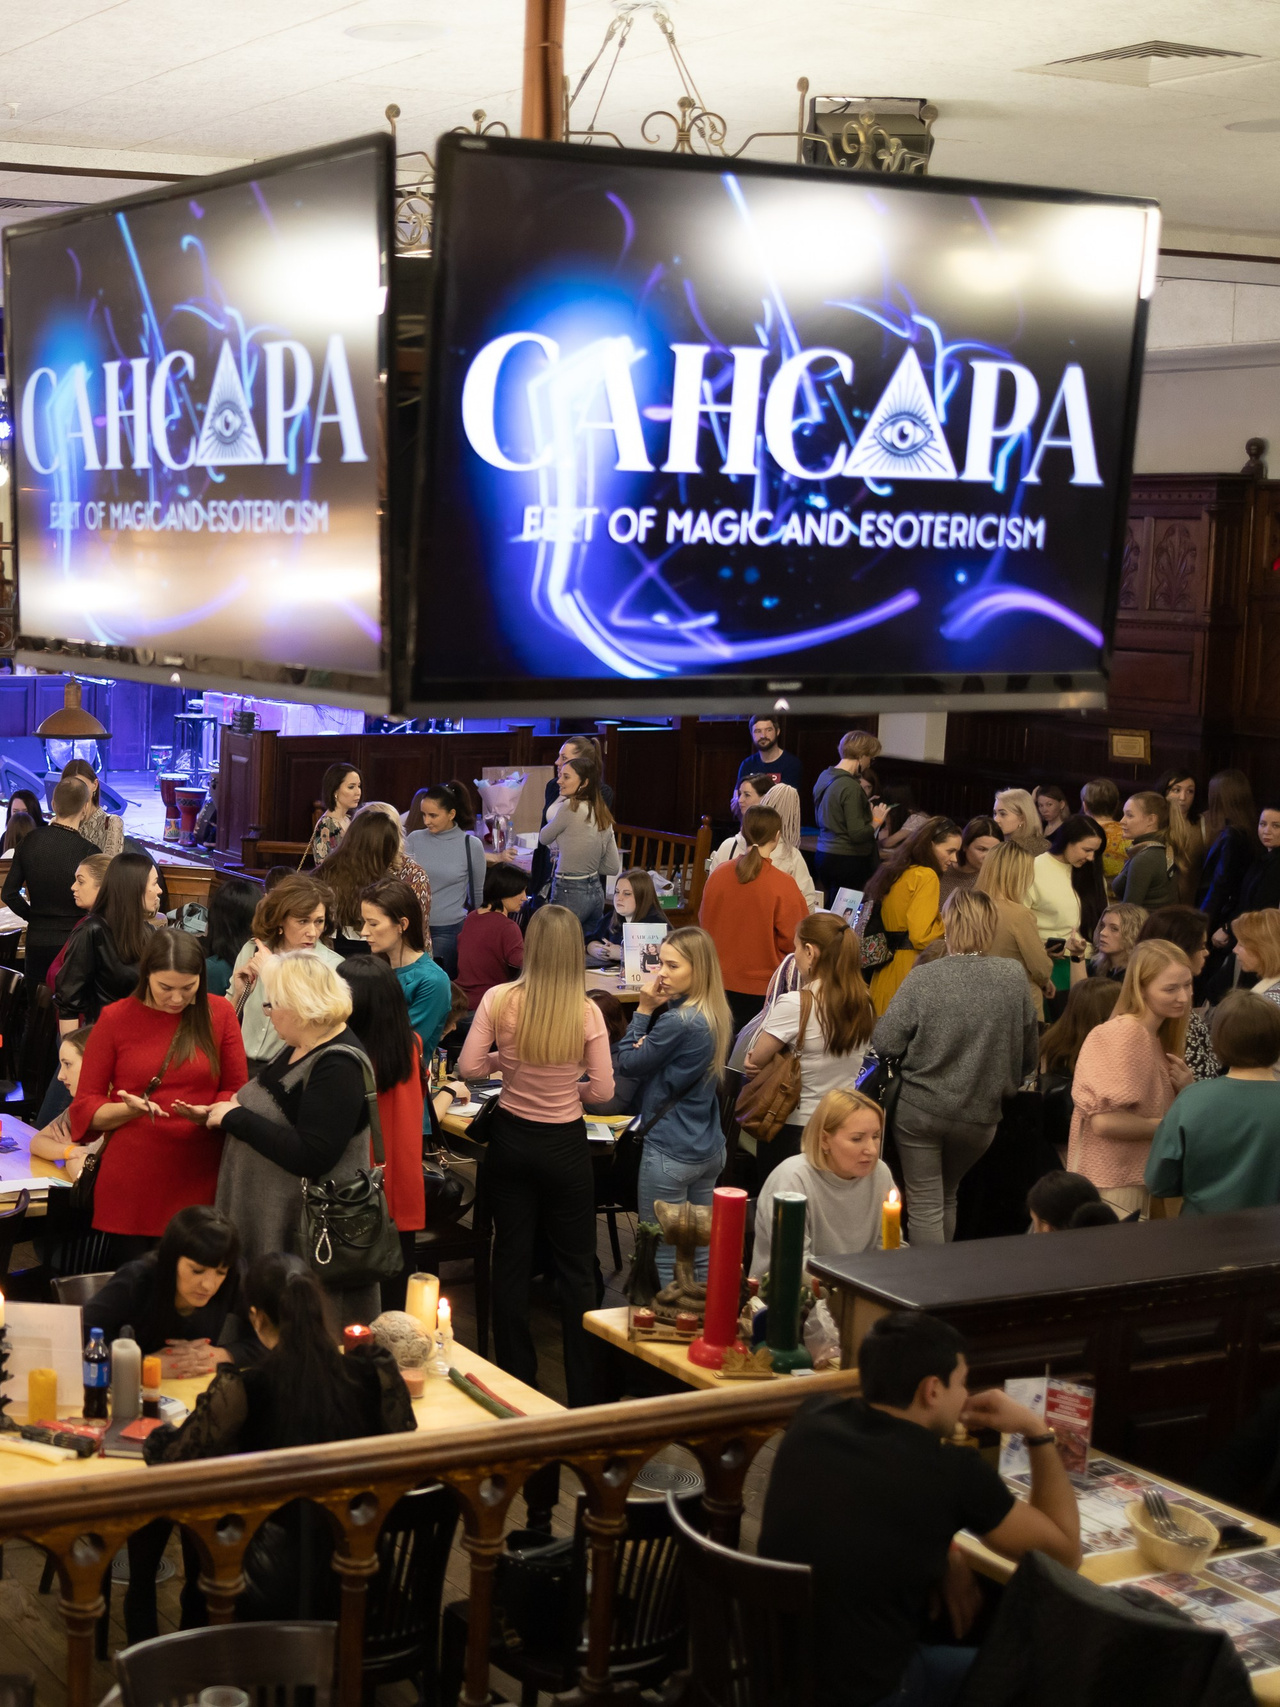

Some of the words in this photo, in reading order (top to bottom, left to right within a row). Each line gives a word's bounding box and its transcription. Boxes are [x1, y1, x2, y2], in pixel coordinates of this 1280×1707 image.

[85, 501, 107, 531] OF
[110, 501, 162, 532] MAGIC
[168, 500, 203, 532] AND
[208, 500, 329, 534] ESOTERICISM
[608, 506, 657, 544] OF
[666, 508, 775, 546] MAGIC
[781, 511, 851, 547] AND
[859, 511, 1047, 550] ESOTERICISM
[631, 974, 641, 982] 10
